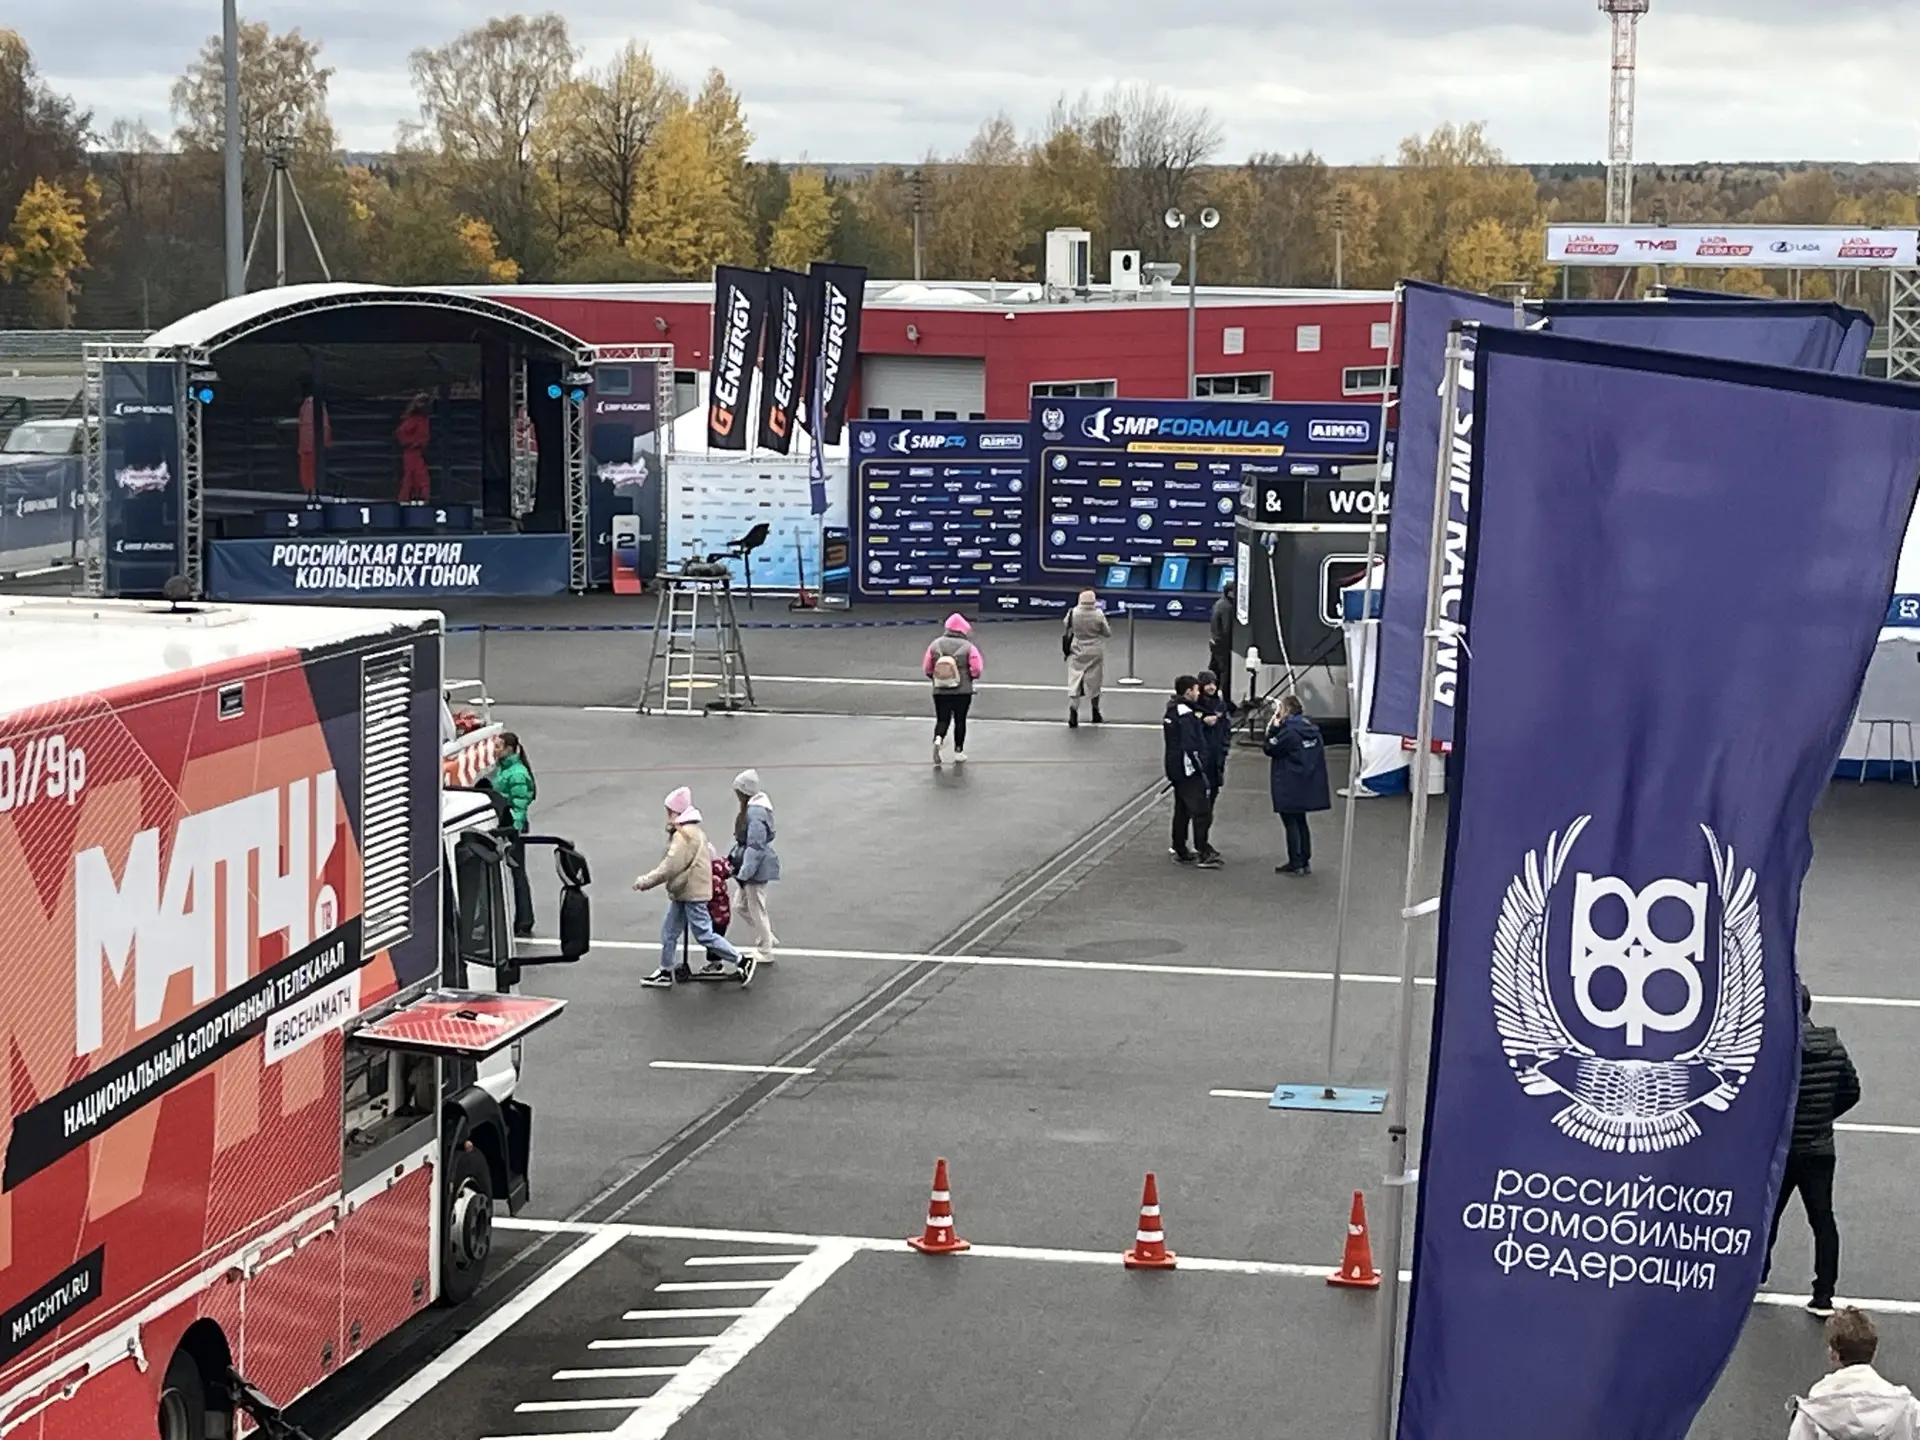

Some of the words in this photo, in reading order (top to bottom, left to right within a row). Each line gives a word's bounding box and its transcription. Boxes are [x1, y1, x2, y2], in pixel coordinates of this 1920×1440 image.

[1635, 240, 1677, 250] TMS
[1112, 417, 1158, 436] SMP
[1157, 421, 1270, 438] FORMULA
[1311, 424, 1366, 437] AIMOL
[911, 435, 945, 448] SMP
[1266, 490, 1281, 512] &
[359, 508, 370, 524] 1
[616, 533, 636, 549] 2
[271, 540, 397, 566] РОССИЙСКАЯ
[401, 543, 462, 565] СЕРИЯ
[296, 565, 416, 590] КОЛЬЦЕВЫХ
[419, 564, 482, 586] ГОНОК
[1110, 570, 1126, 583] 3
[1168, 563, 1179, 583] 1
[272, 984, 353, 1051] #ВСЕНАМАТЧ
[63, 1032, 186, 1138] НАЦИОНАЛЬНЫЙ
[187, 978, 276, 1058] СПОРТИВНЫЙ
[276, 941, 346, 1003] ТЕЛЕКАНАЛ
[1494, 1168, 1734, 1217] российская
[1462, 1202, 1751, 1255] автомобильная
[1493, 1234, 1716, 1291] федерация
[12, 1270, 89, 1342] MATCHTV.RU
